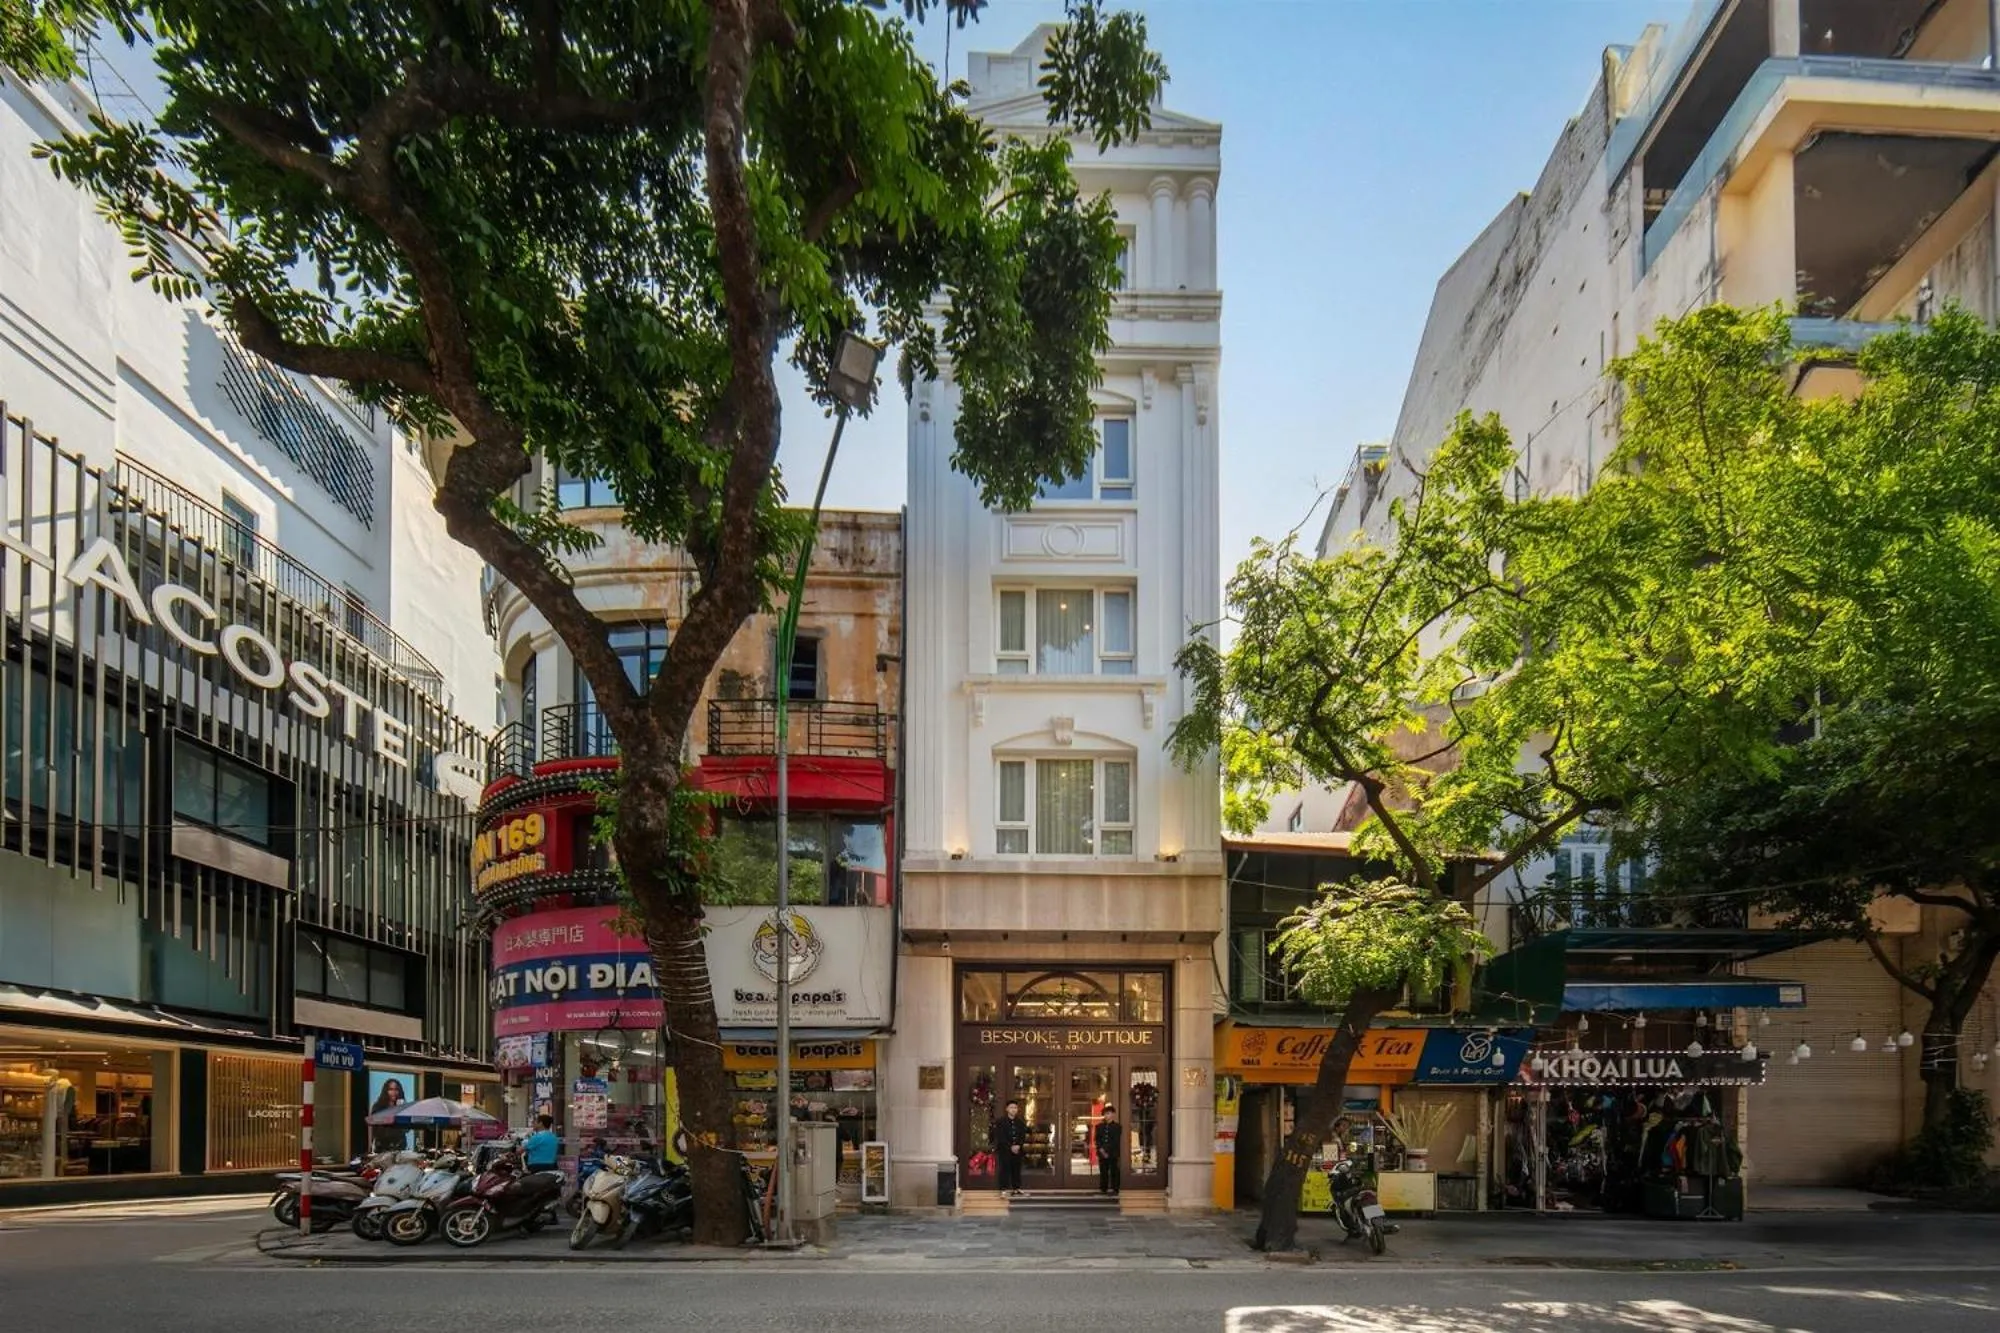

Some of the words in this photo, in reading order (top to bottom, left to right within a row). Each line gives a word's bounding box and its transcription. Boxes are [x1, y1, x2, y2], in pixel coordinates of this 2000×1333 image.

[497, 813, 545, 855] 169
[525, 960, 576, 999] NỘI
[587, 962, 659, 996] ĐỊA
[981, 1030, 1060, 1045] BESPOKE
[1068, 1030, 1153, 1045] BOUTIQUE
[1374, 1036, 1414, 1055] Tea
[248, 1109, 293, 1118] LACOSTE
